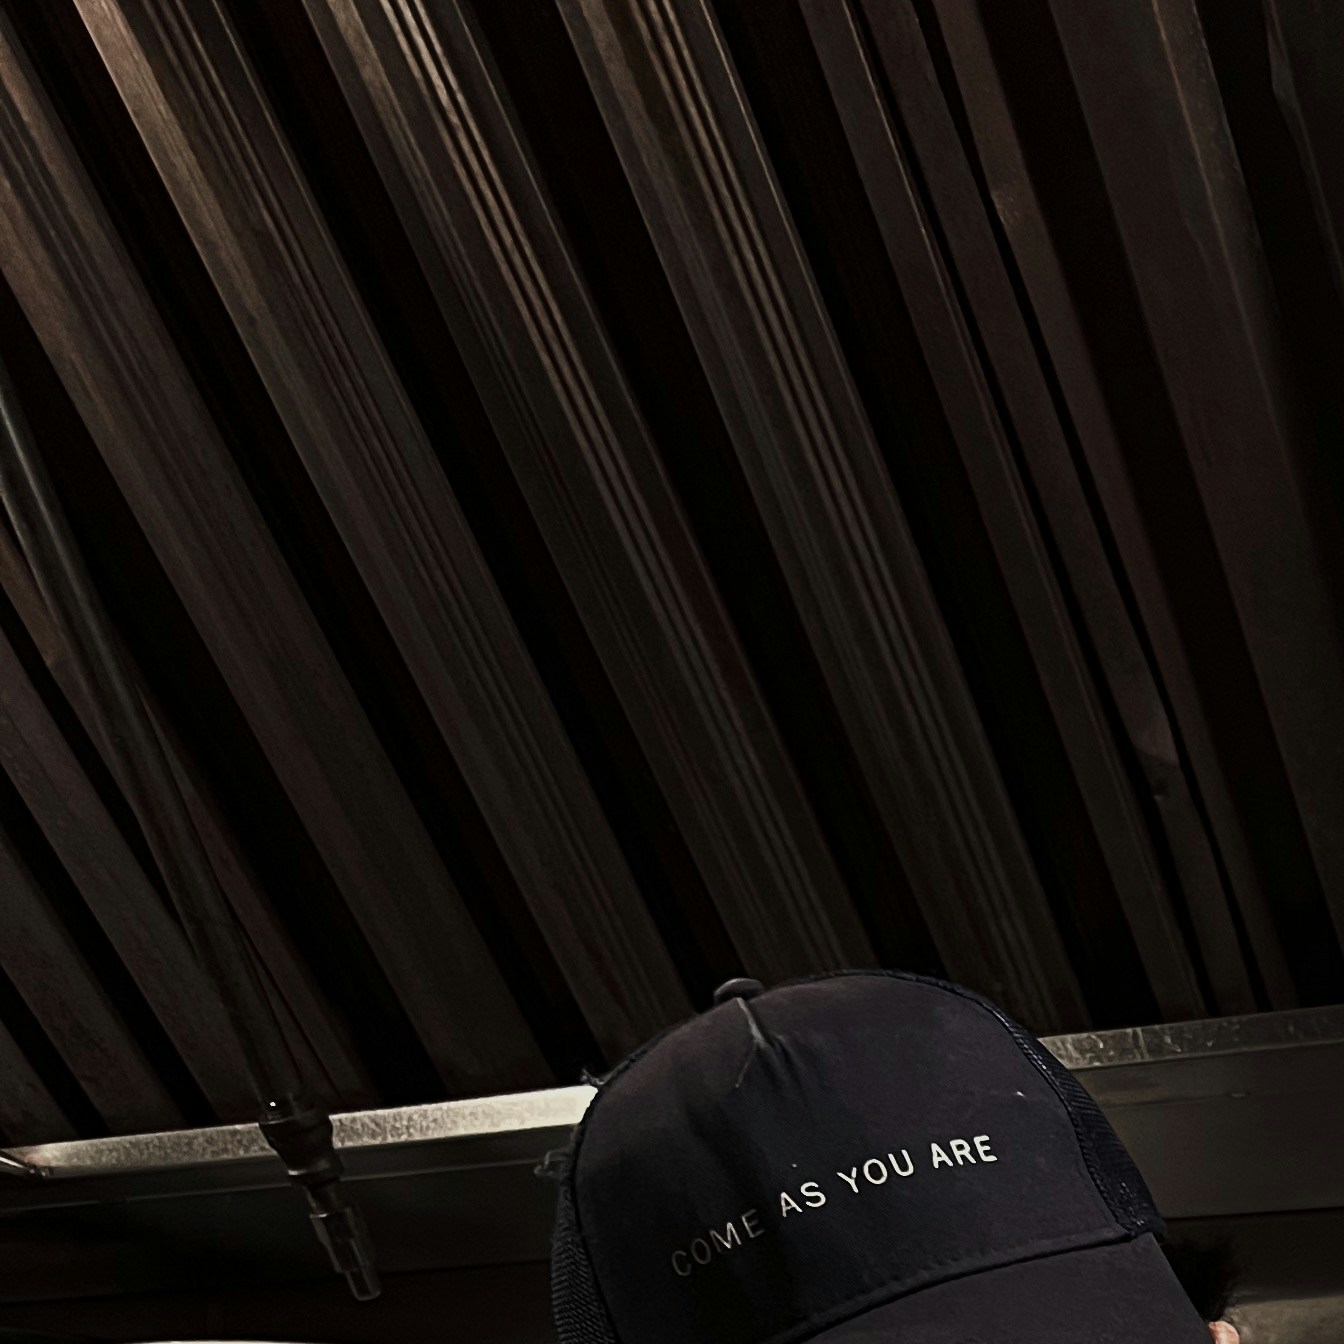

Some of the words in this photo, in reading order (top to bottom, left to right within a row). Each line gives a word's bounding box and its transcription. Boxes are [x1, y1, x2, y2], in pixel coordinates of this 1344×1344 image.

[671, 1208, 766, 1278] COME
[779, 1181, 828, 1218] AS
[836, 1149, 915, 1194] YOU
[929, 1134, 998, 1169] ARE
